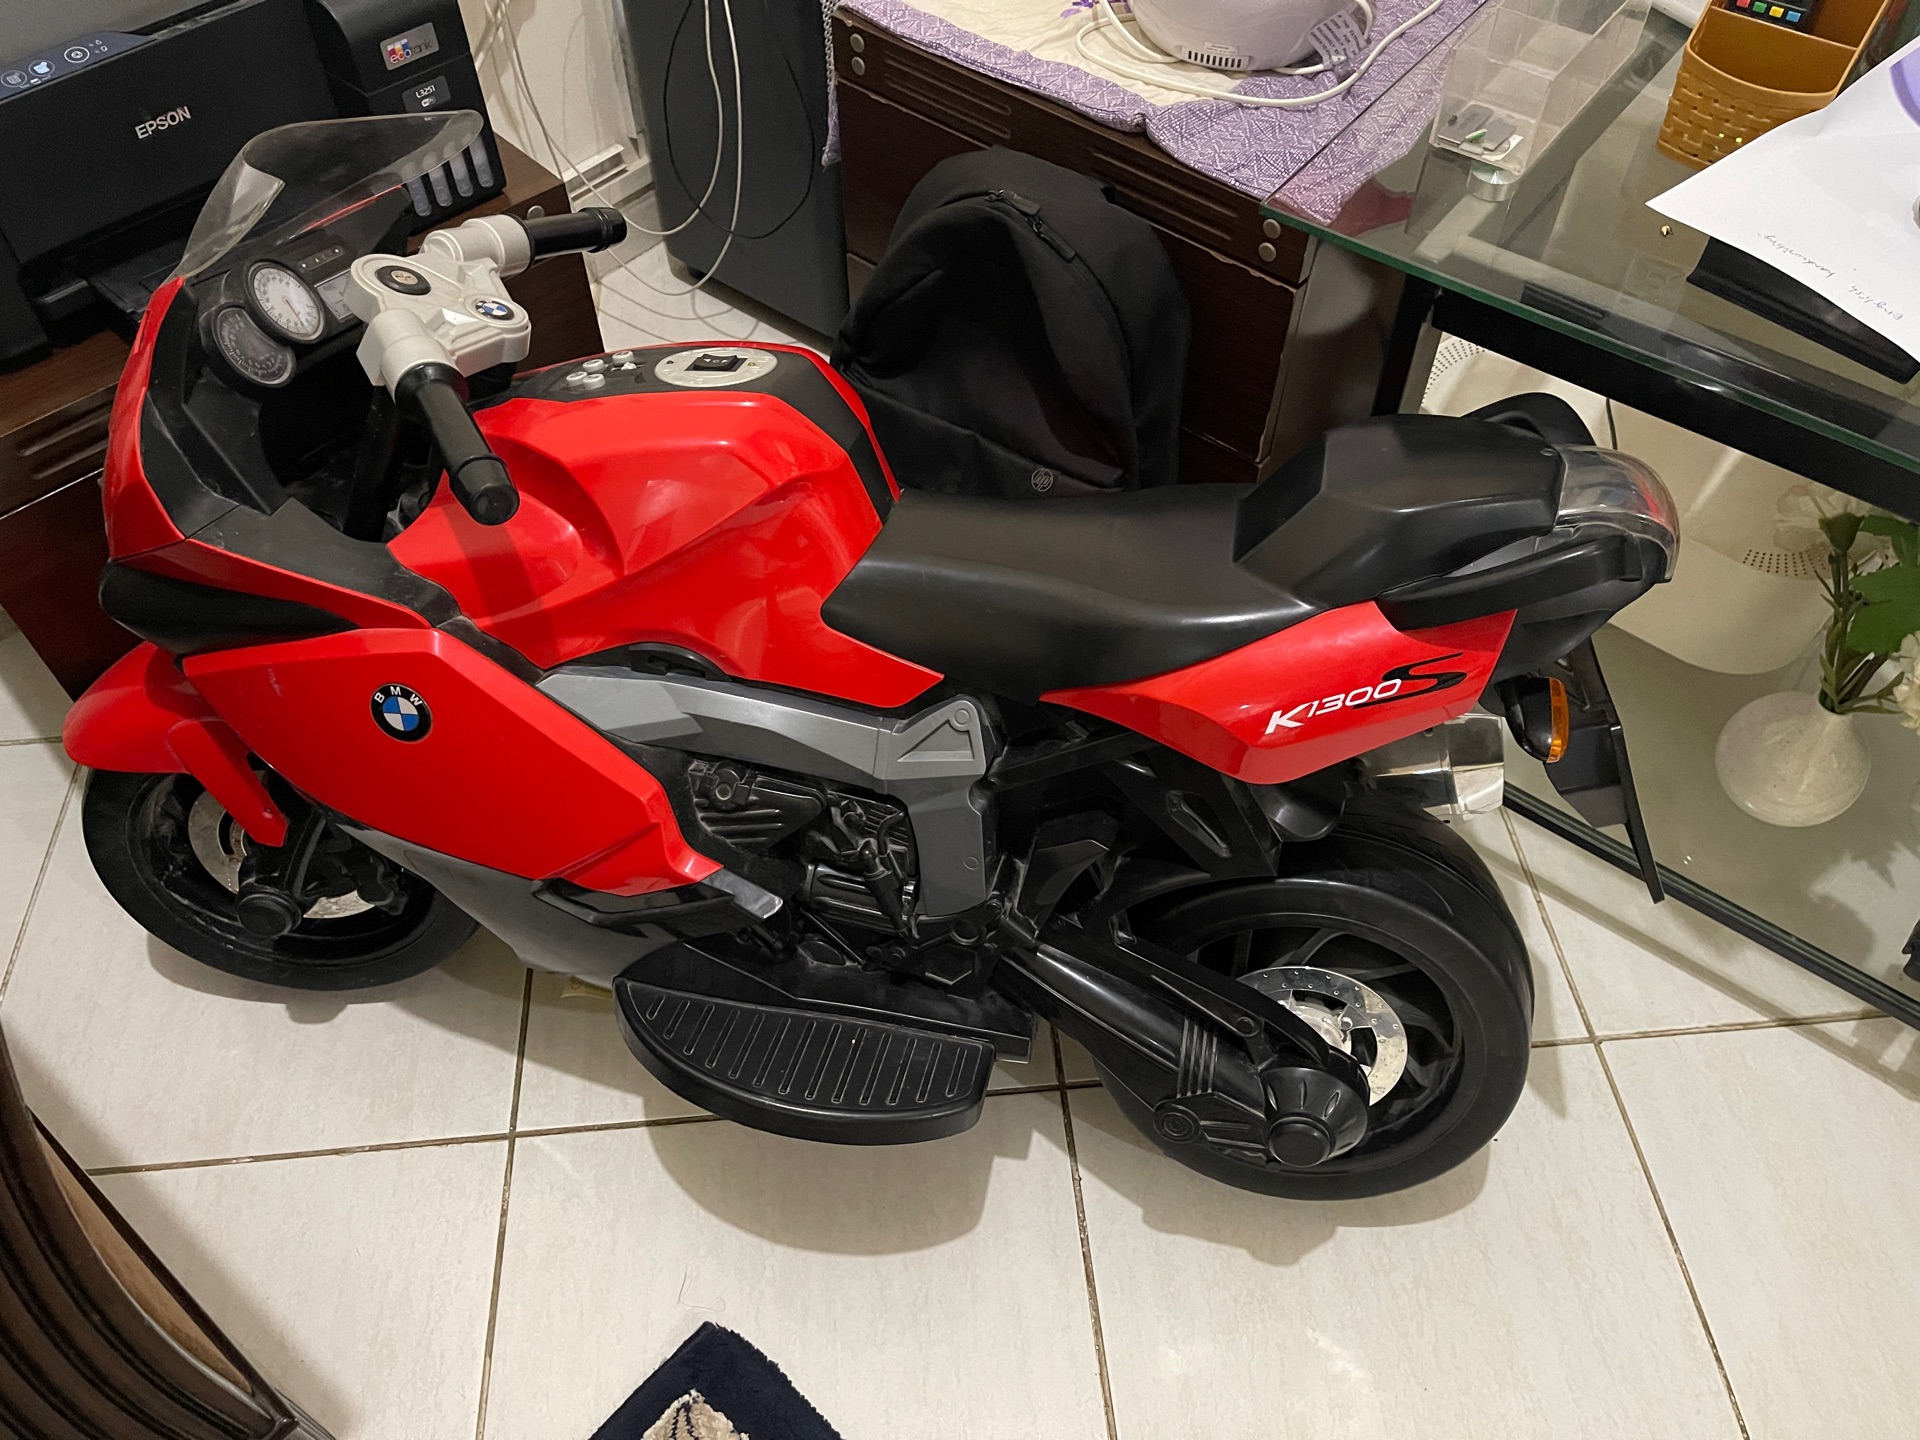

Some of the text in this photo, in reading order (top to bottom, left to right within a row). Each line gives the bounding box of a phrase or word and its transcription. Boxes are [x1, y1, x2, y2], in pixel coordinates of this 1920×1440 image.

[415, 84, 436, 99] L3251
[135, 106, 192, 139] EPSON
[373, 685, 423, 706] BMW
